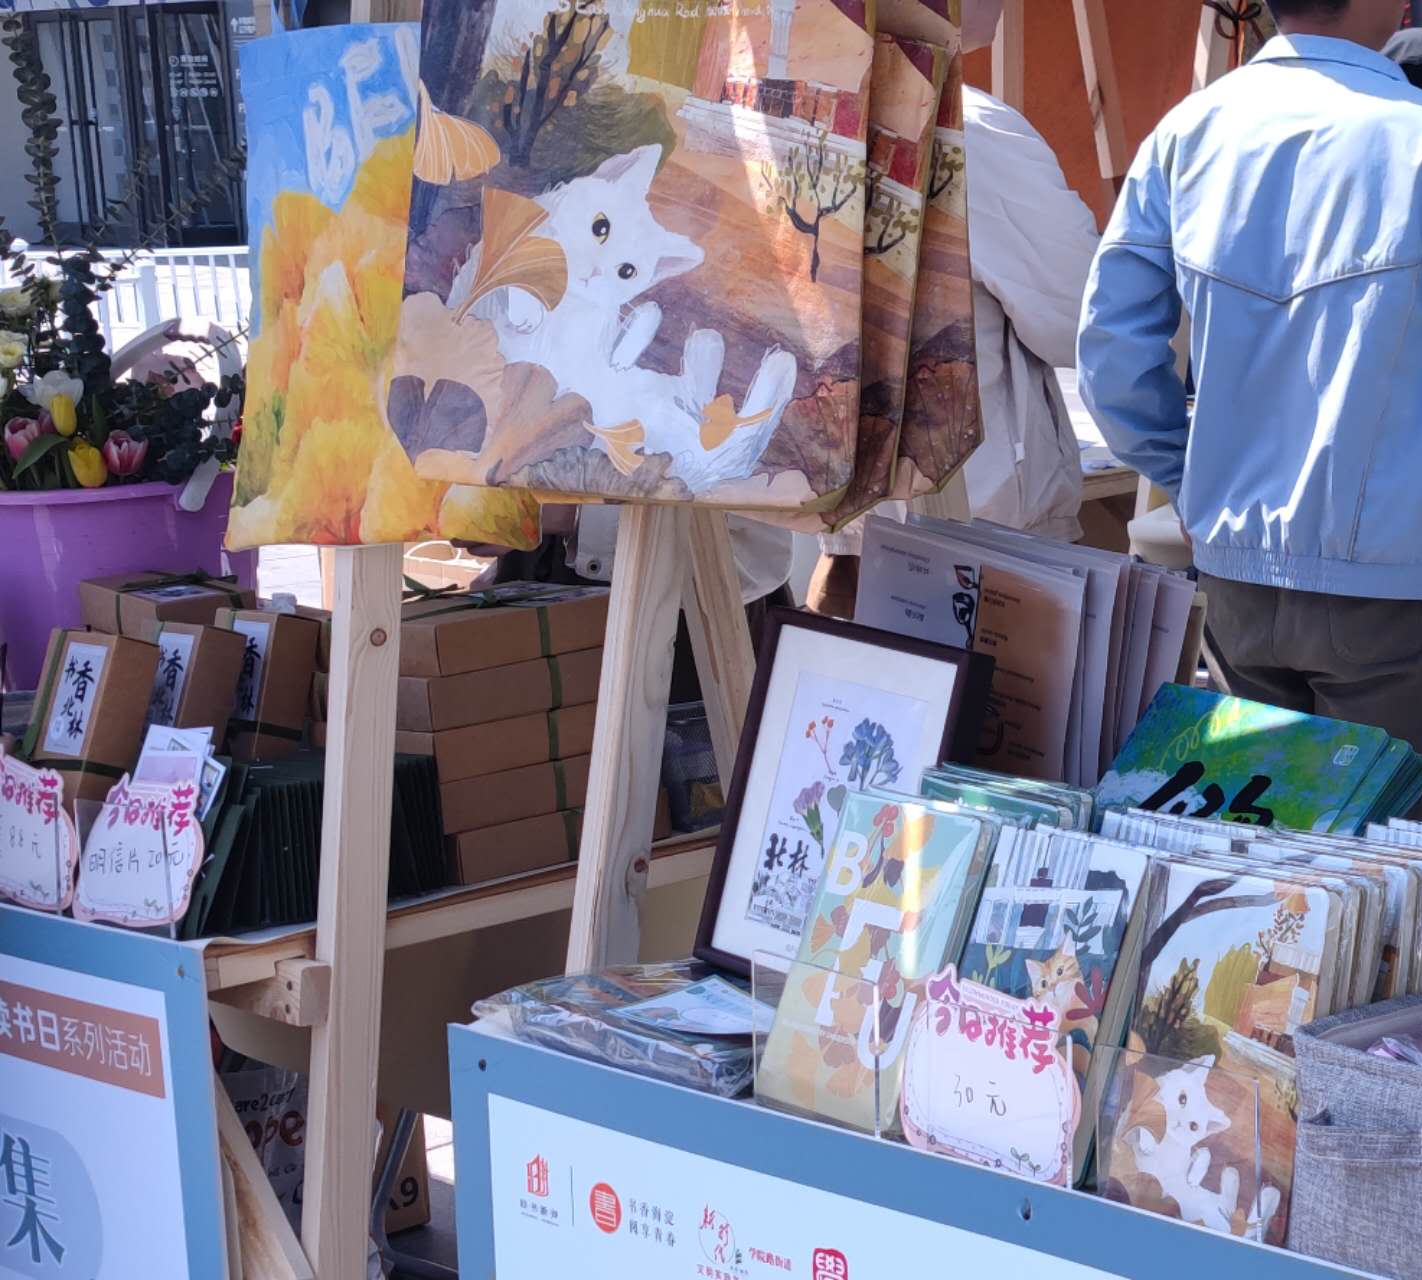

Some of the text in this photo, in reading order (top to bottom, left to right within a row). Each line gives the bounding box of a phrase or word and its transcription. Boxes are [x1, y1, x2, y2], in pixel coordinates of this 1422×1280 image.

[0, 758, 59, 826] 日推荐
[104, 782, 195, 837] 今日推荐
[928, 974, 1055, 1074] 今日推荐
